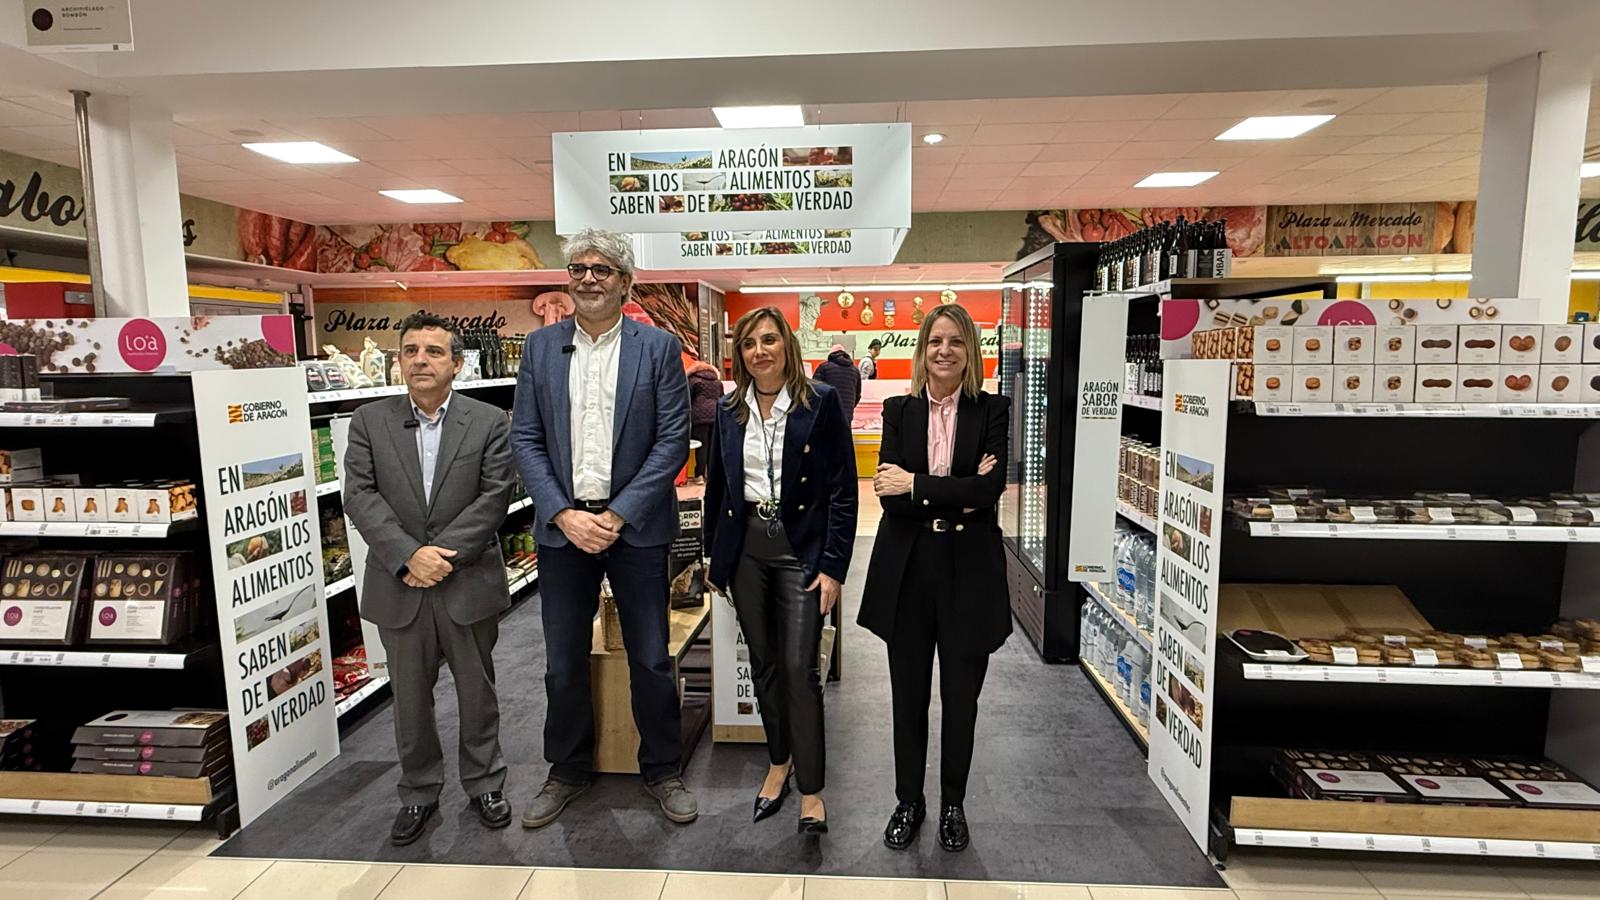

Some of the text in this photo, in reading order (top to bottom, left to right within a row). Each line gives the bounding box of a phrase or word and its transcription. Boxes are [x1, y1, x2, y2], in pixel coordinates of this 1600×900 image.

[608, 144, 778, 172] EN ARAGÓN
[652, 170, 811, 192] LOS ALIMENTOS
[610, 191, 853, 215] SABEN DE VERDAD
[1279, 212, 1331, 229] Plaza
[1350, 211, 1422, 227] Mercado
[681, 240, 852, 257] SABEN DE VERDAD
[324, 309, 390, 333] Plaza
[417, 309, 508, 331] ercado
[880, 332, 919, 350] Plaz
[1082, 393, 1118, 407] SABOR
[1083, 380, 1119, 393] ARAGÓN
[243, 400, 281, 412] GOBIERNO
[244, 413, 255, 422] DE
[1081, 407, 1117, 416] DE VERDAD
[218, 464, 241, 496] EN
[1165, 450, 1176, 480] EN
[224, 491, 289, 537] ARAGÓN
[1163, 489, 1199, 531] ARAGÓN
[284, 518, 311, 551] LOS
[1192, 536, 1210, 574] LOS
[232, 551, 314, 609] ALIMENTOS
[1161, 557, 1208, 615] ALIMENTOS
[238, 632, 288, 680] SABEN
[1158, 626, 1184, 672] SABEN
[1156, 658, 1167, 695] DE
[242, 681, 263, 716] DE
[271, 680, 326, 733] VERDAD
[1168, 706, 1202, 769] VERDAD
